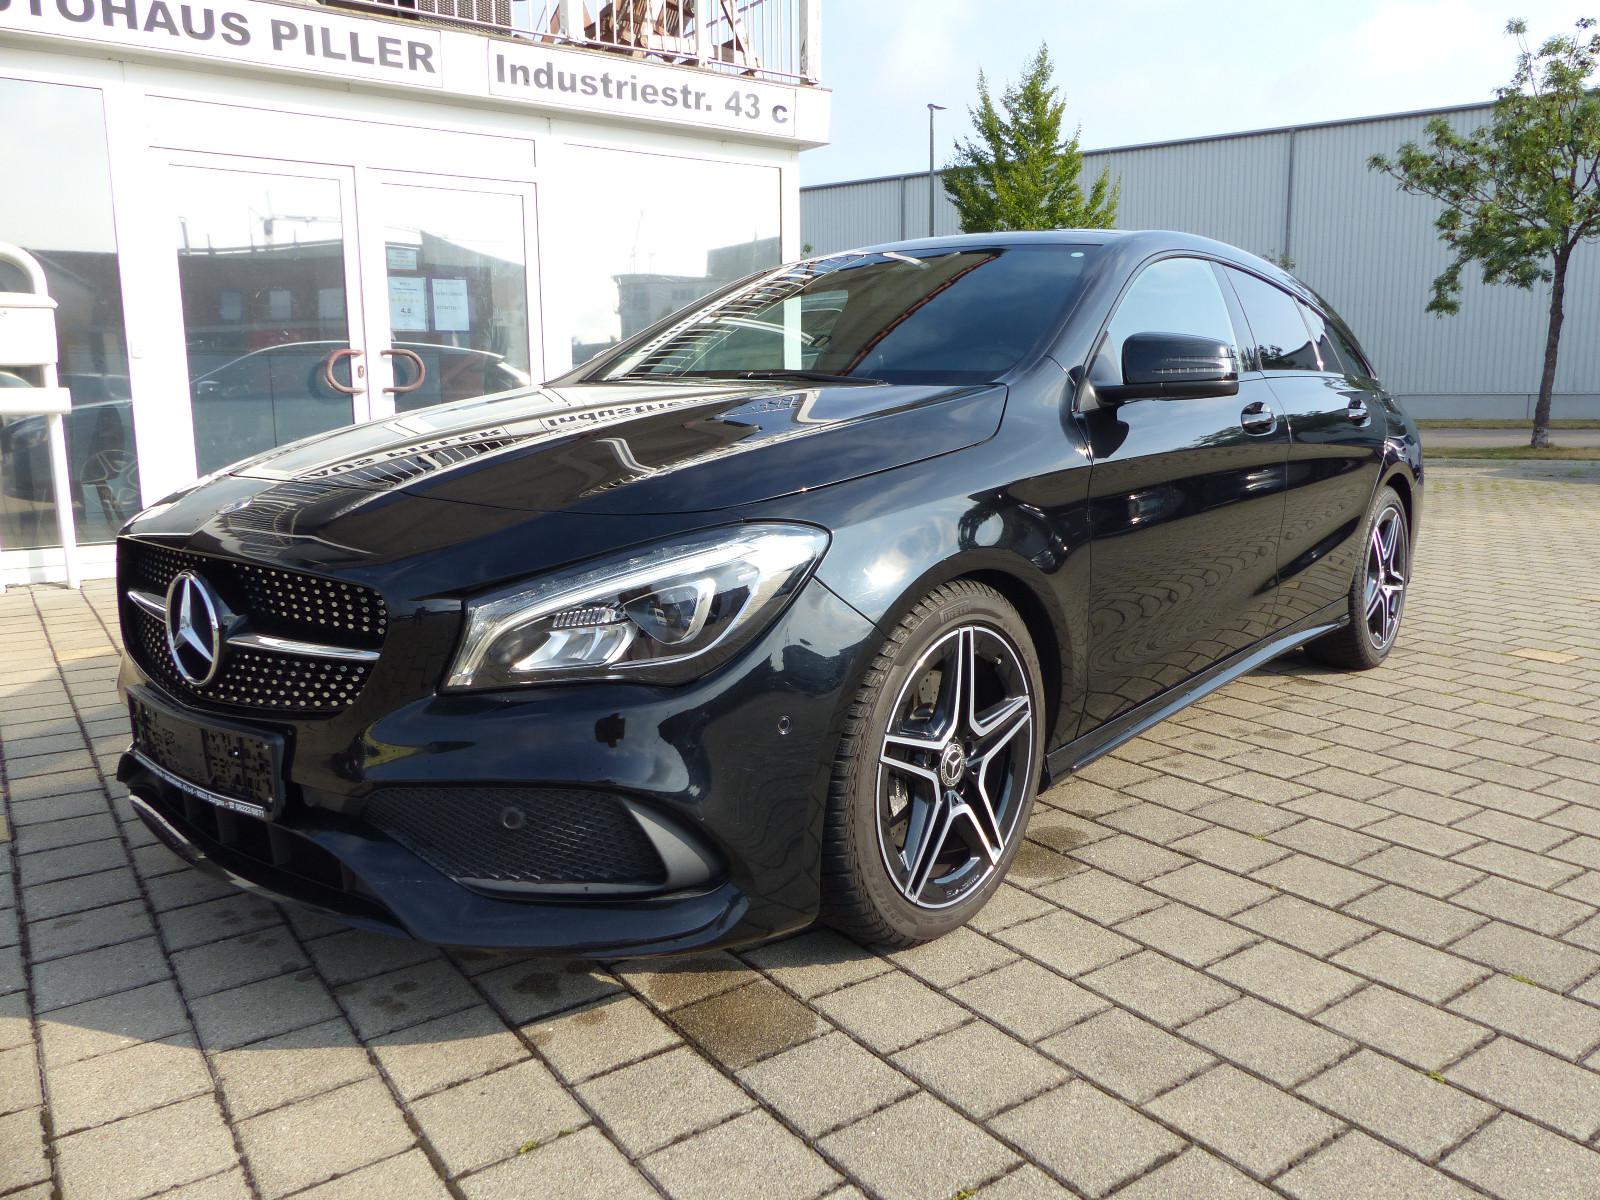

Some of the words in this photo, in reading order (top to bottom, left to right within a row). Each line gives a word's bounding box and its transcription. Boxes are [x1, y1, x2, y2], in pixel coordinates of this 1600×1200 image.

[271, 18, 436, 74] PILLER
[496, 53, 712, 112] Industriestr.
[724, 90, 761, 120] 43
[771, 104, 788, 125] c
